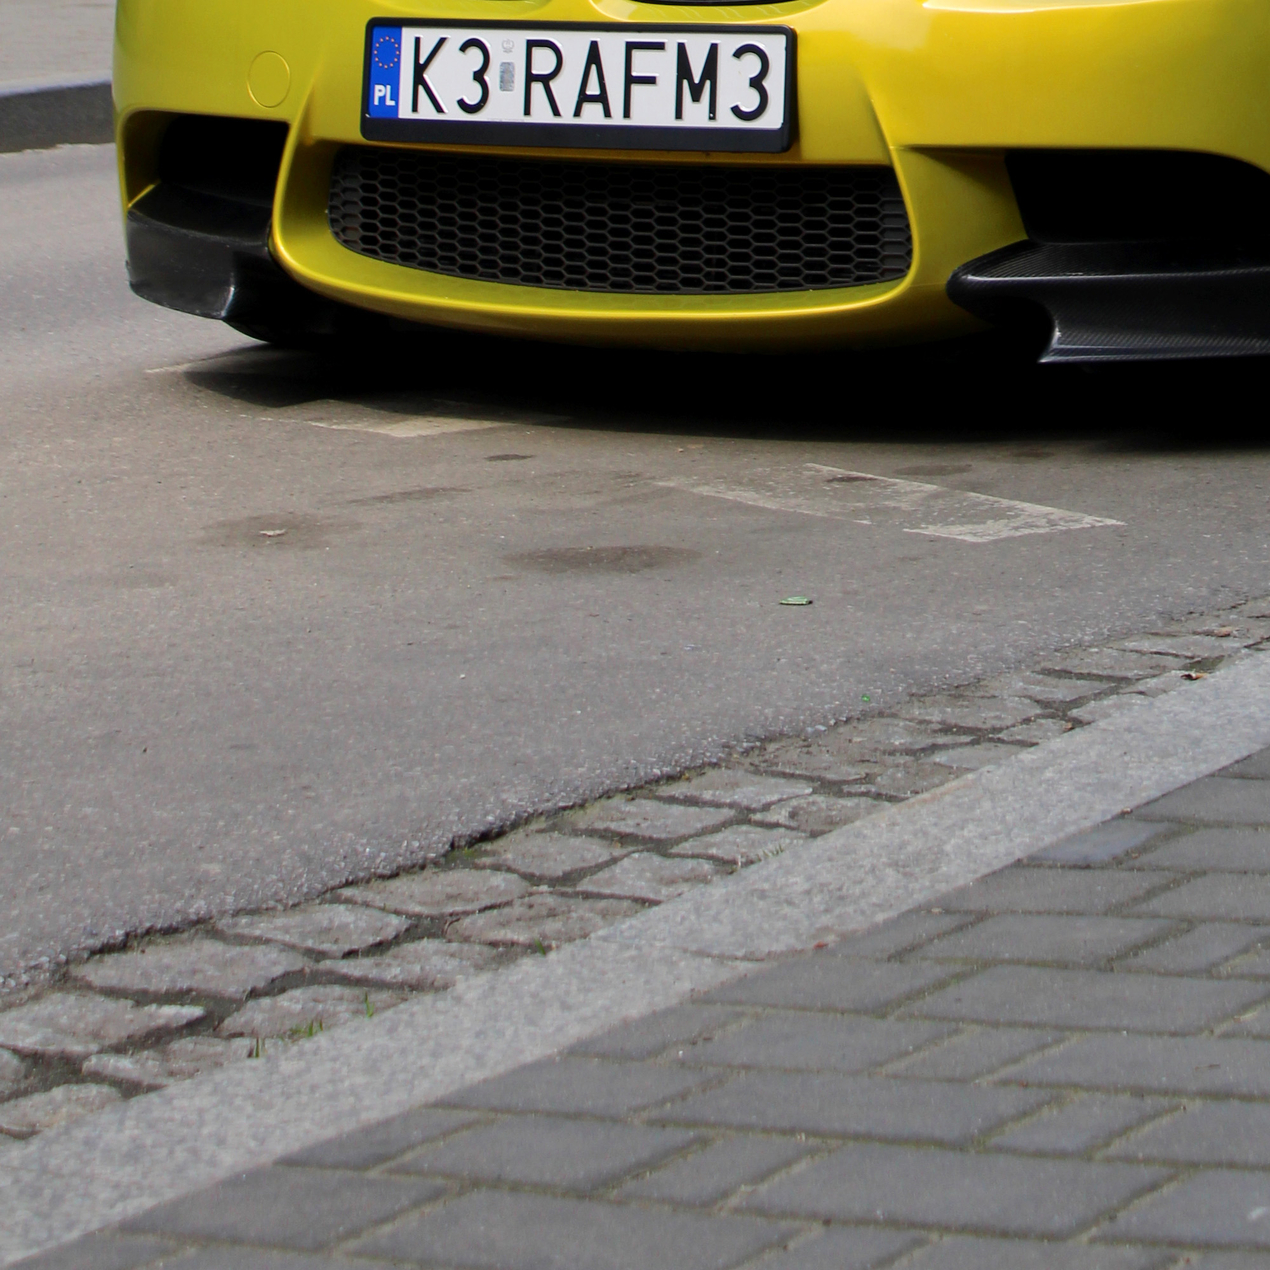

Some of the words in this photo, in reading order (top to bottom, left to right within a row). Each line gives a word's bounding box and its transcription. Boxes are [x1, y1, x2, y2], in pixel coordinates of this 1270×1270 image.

[373, 84, 396, 107] PL
[411, 36, 491, 115] K3
[523, 38, 770, 122] RAFM3
